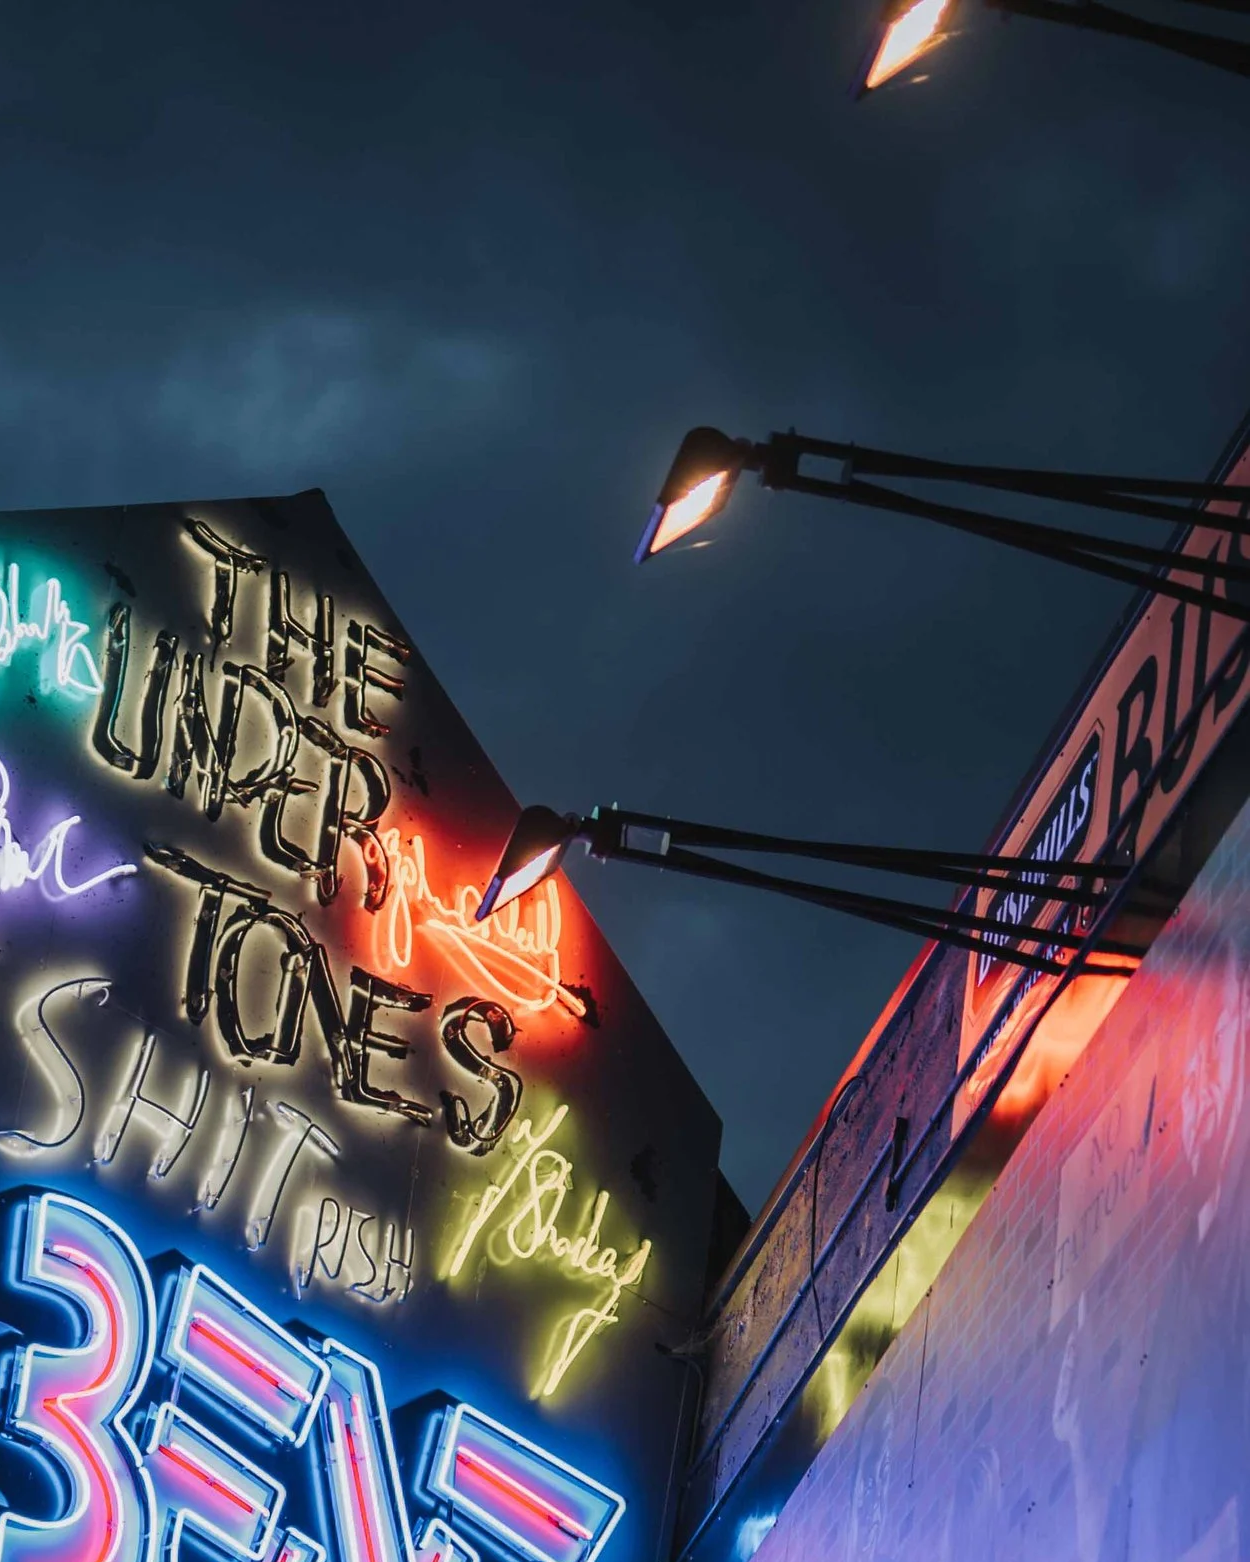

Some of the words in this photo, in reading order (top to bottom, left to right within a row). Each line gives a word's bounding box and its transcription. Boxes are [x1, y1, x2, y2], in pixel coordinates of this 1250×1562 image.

[93, 602, 392, 912] UNDER
[184, 517, 412, 739] THE
[143, 840, 524, 1158] TONES
